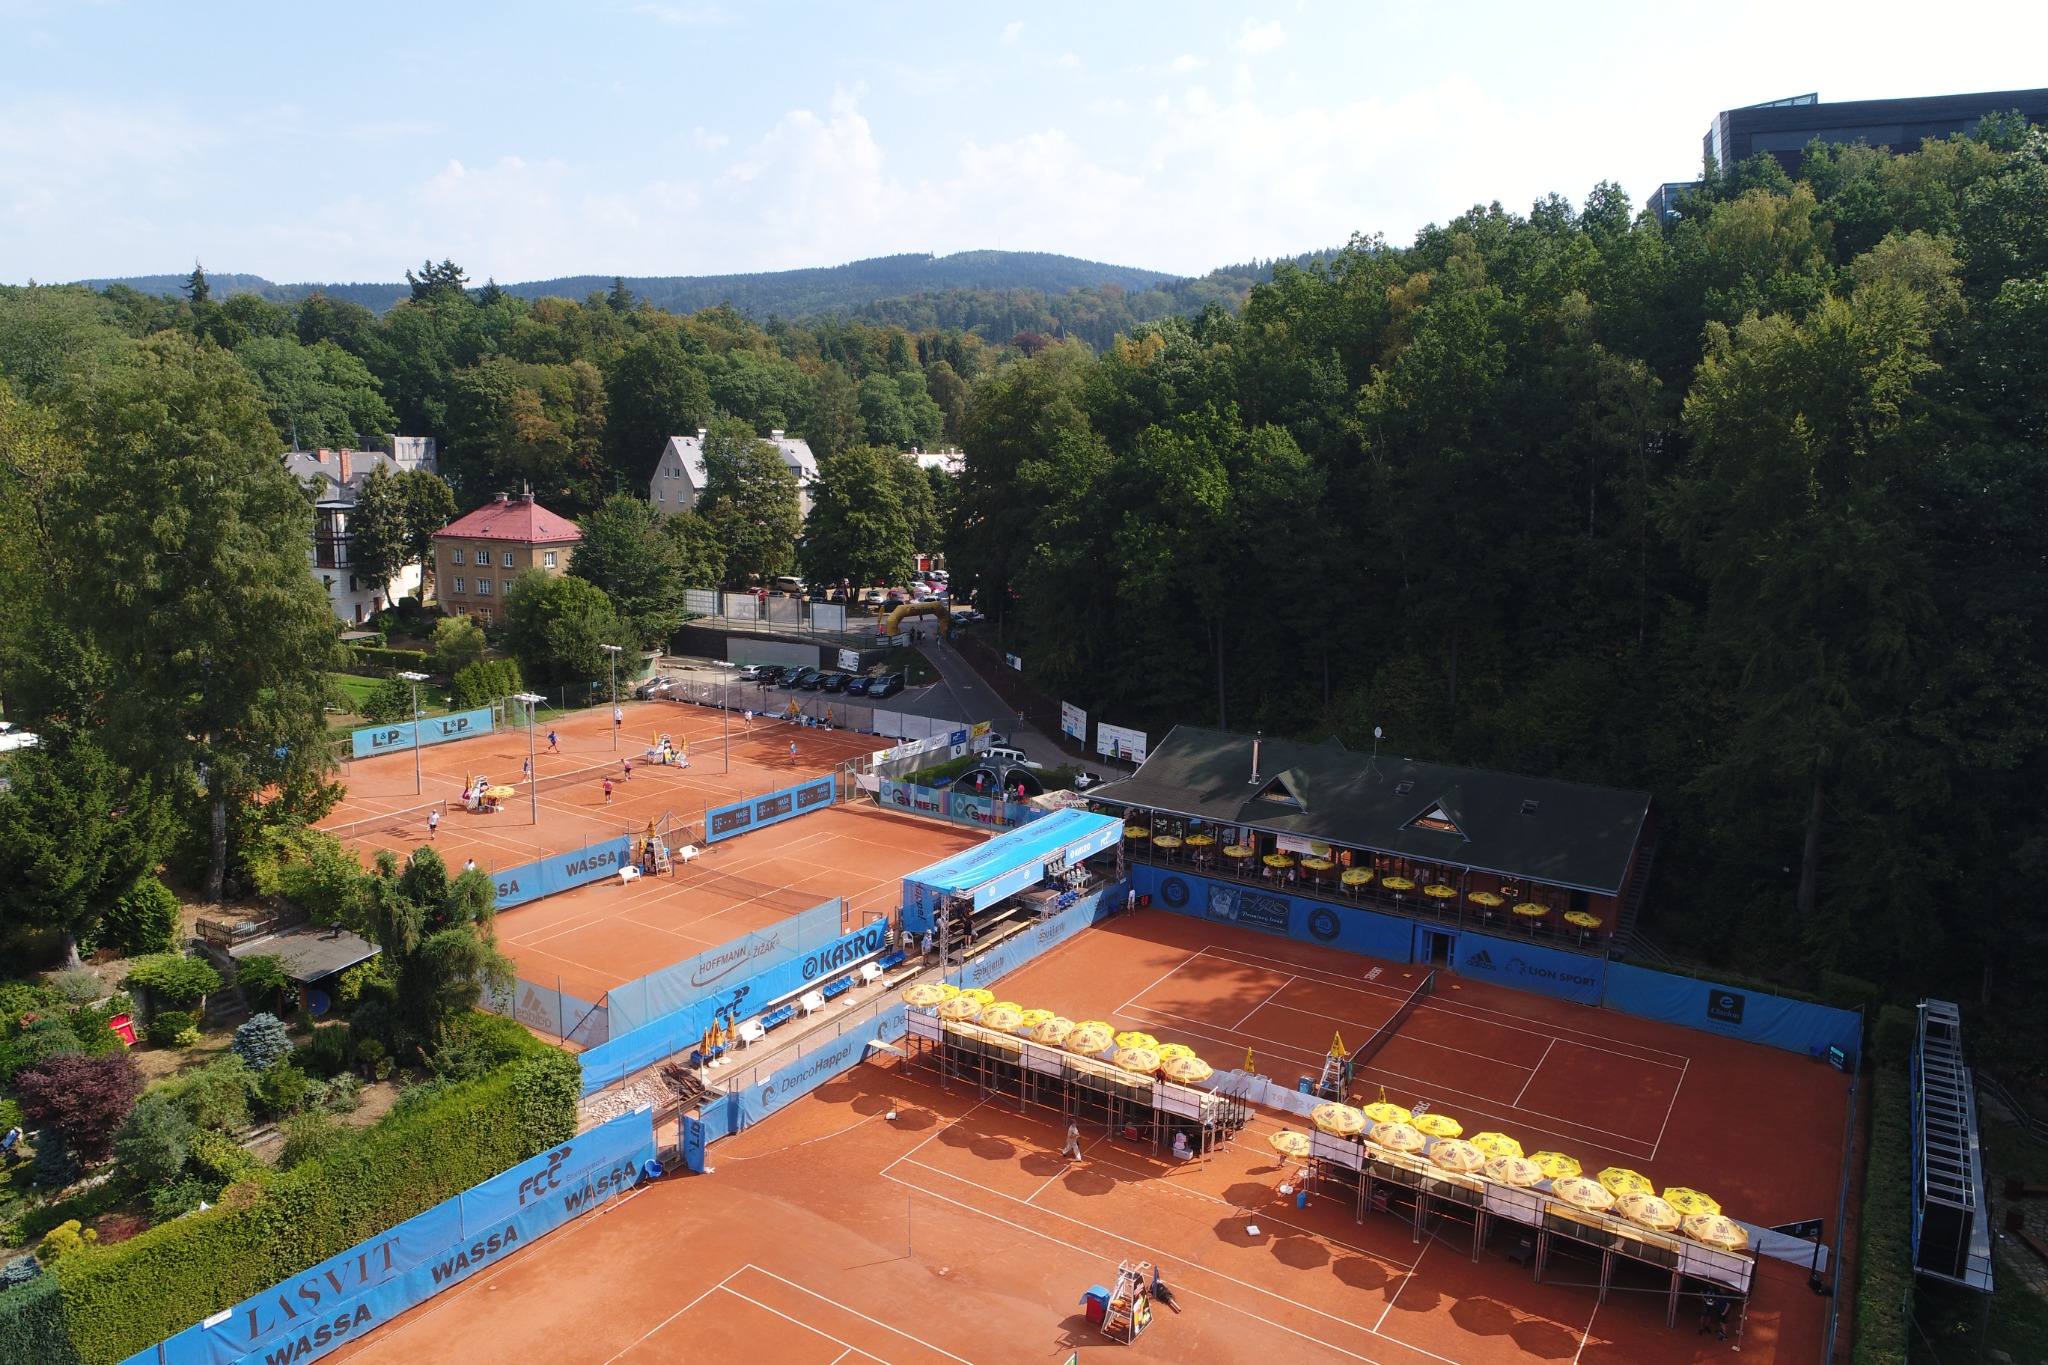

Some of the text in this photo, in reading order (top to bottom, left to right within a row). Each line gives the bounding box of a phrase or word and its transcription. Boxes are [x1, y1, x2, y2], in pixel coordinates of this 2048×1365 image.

[372, 730, 400, 747] L&P
[443, 718, 468, 735] L&P
[971, 812, 1016, 828] SYNER
[566, 851, 617, 877] WASSA
[699, 945, 747, 974] HOFFMANN
[820, 929, 878, 974] KASRO
[1529, 965, 1596, 987] LION SPORT
[781, 1041, 852, 1093] DencoHappel
[564, 1160, 637, 1212] WASSA
[432, 1224, 518, 1284] WASSA
[245, 1236, 402, 1341] LASVIT
[265, 1303, 373, 1365] WASSA
